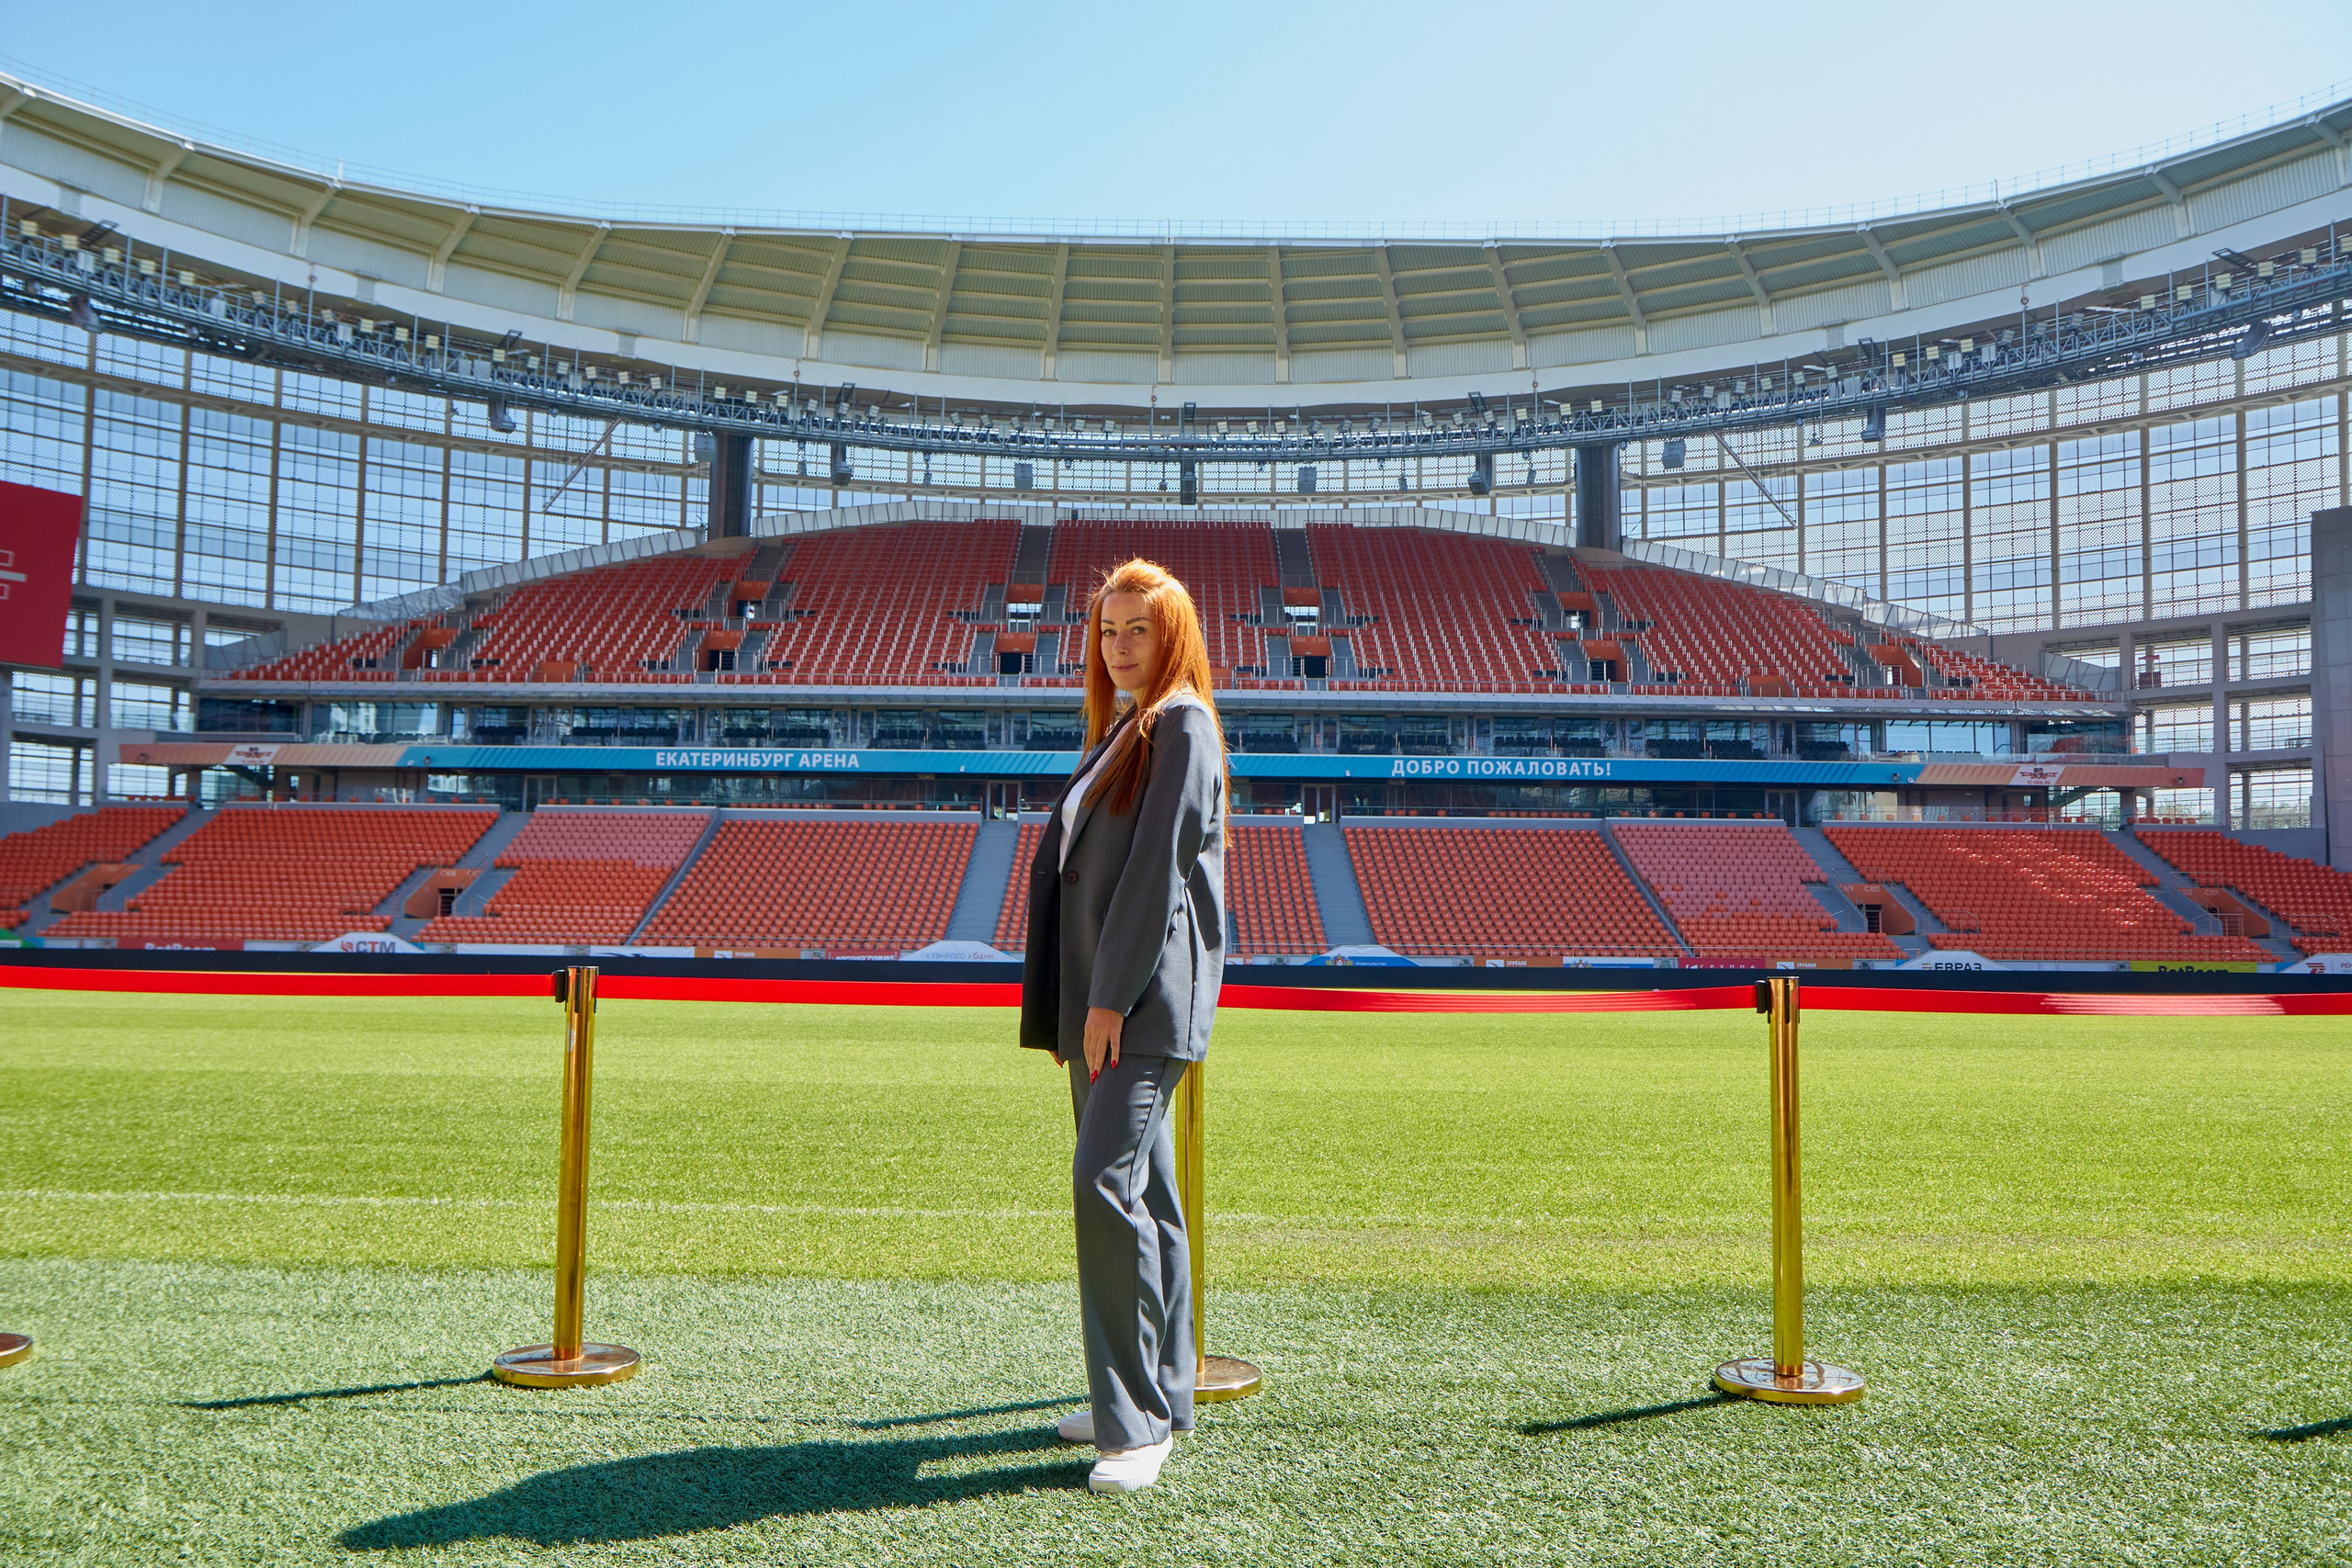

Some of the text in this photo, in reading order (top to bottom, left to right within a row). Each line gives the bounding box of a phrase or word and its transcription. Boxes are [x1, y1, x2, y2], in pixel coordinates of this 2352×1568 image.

[655, 751, 860, 768] ЕКАТЕРИНБУРГ АРЕНА
[1391, 759, 1611, 777] ДОБРО ПОЖАЛОВАТЬ!
[356, 941, 396, 953] СТМ
[921, 952, 966, 960] газэнерго
